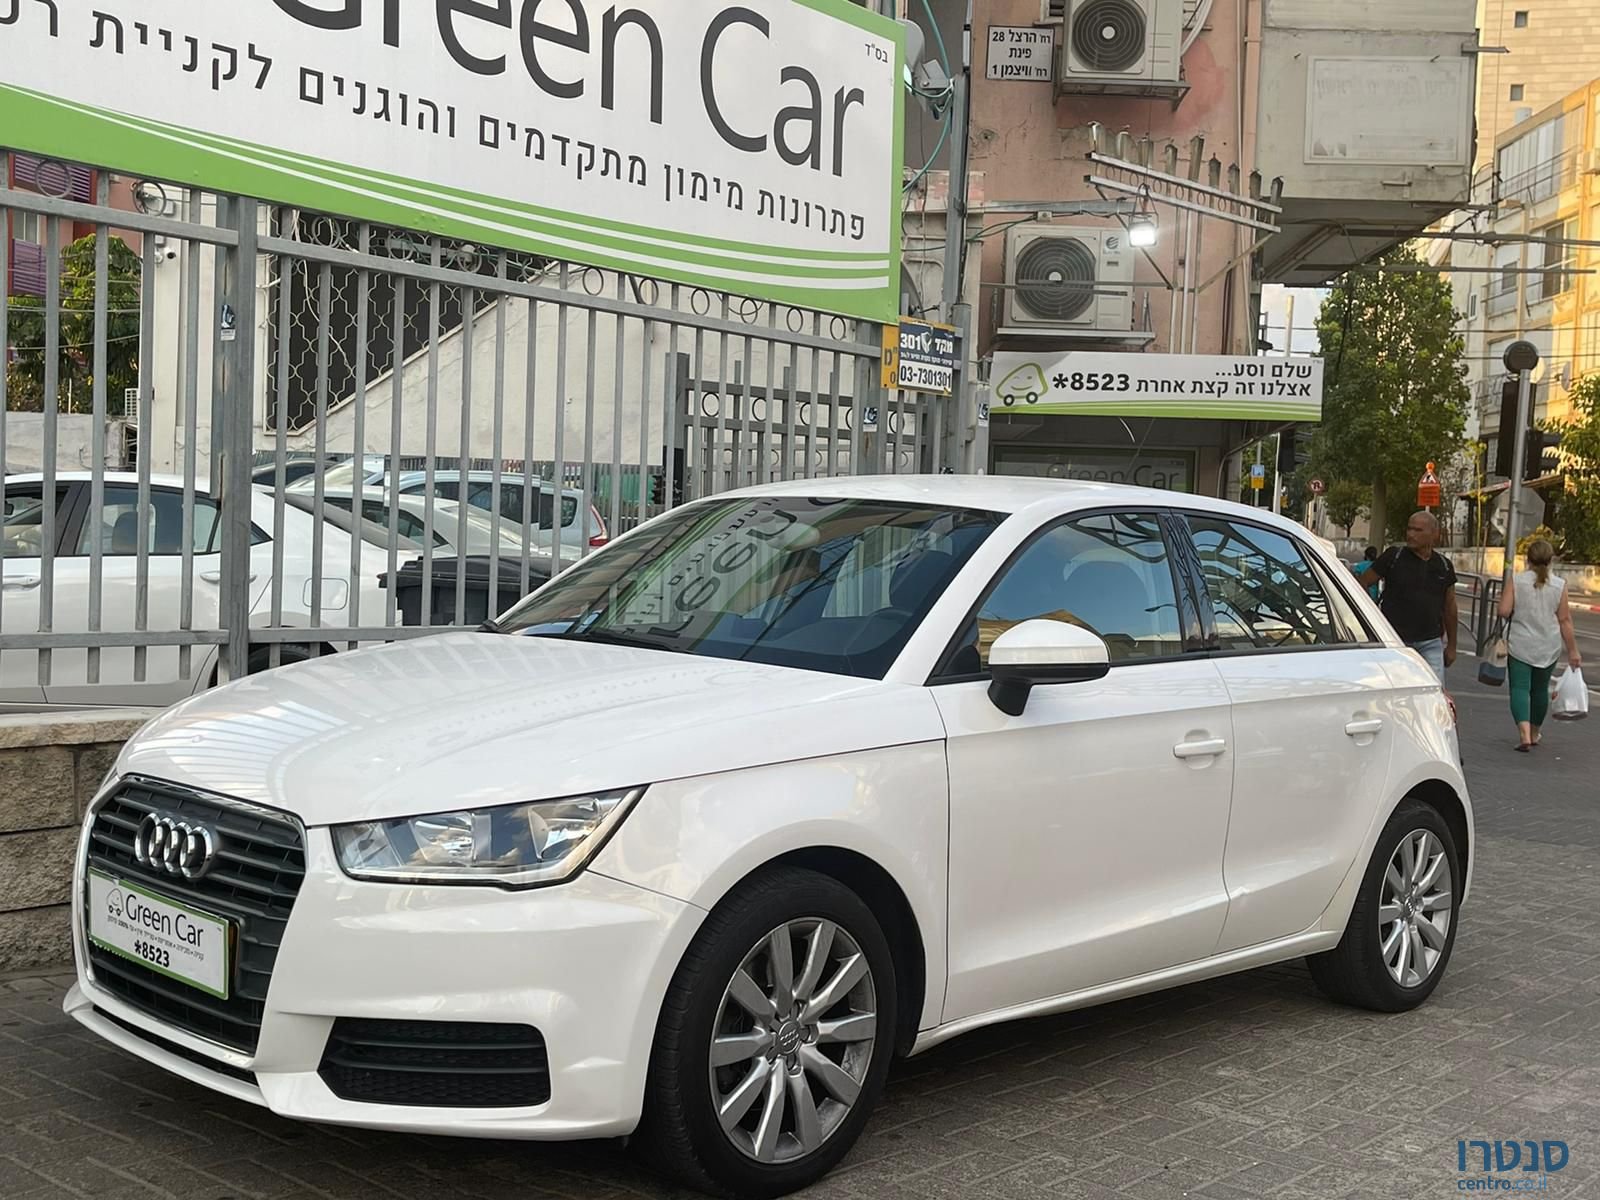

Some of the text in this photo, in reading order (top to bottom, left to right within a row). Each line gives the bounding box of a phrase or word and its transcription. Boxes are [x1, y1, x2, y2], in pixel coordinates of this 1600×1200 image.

[992, 31, 1005, 42] 28
[1009, 29, 1037, 43] הרצל
[89, 10, 274, 91] לקניית
[864, 43, 888, 63] בס"ד
[1008, 48, 1032, 58] פינת
[992, 64, 998, 75] 1
[1000, 64, 1032, 78] וויצמן
[700, 6, 865, 178] Car
[299, 66, 457, 139] והוגנים
[479, 114, 647, 188] מתקדמים
[663, 163, 743, 211] מימון
[757, 189, 865, 242] פתרונות
[900, 333, 921, 351] 301
[900, 365, 952, 389] 03-7301301
[1215, 361, 1313, 379] שלם וסע...
[1135, 379, 1312, 399] אצלנו זה קצת אחרת
[125, 894, 204, 947] Green Car
